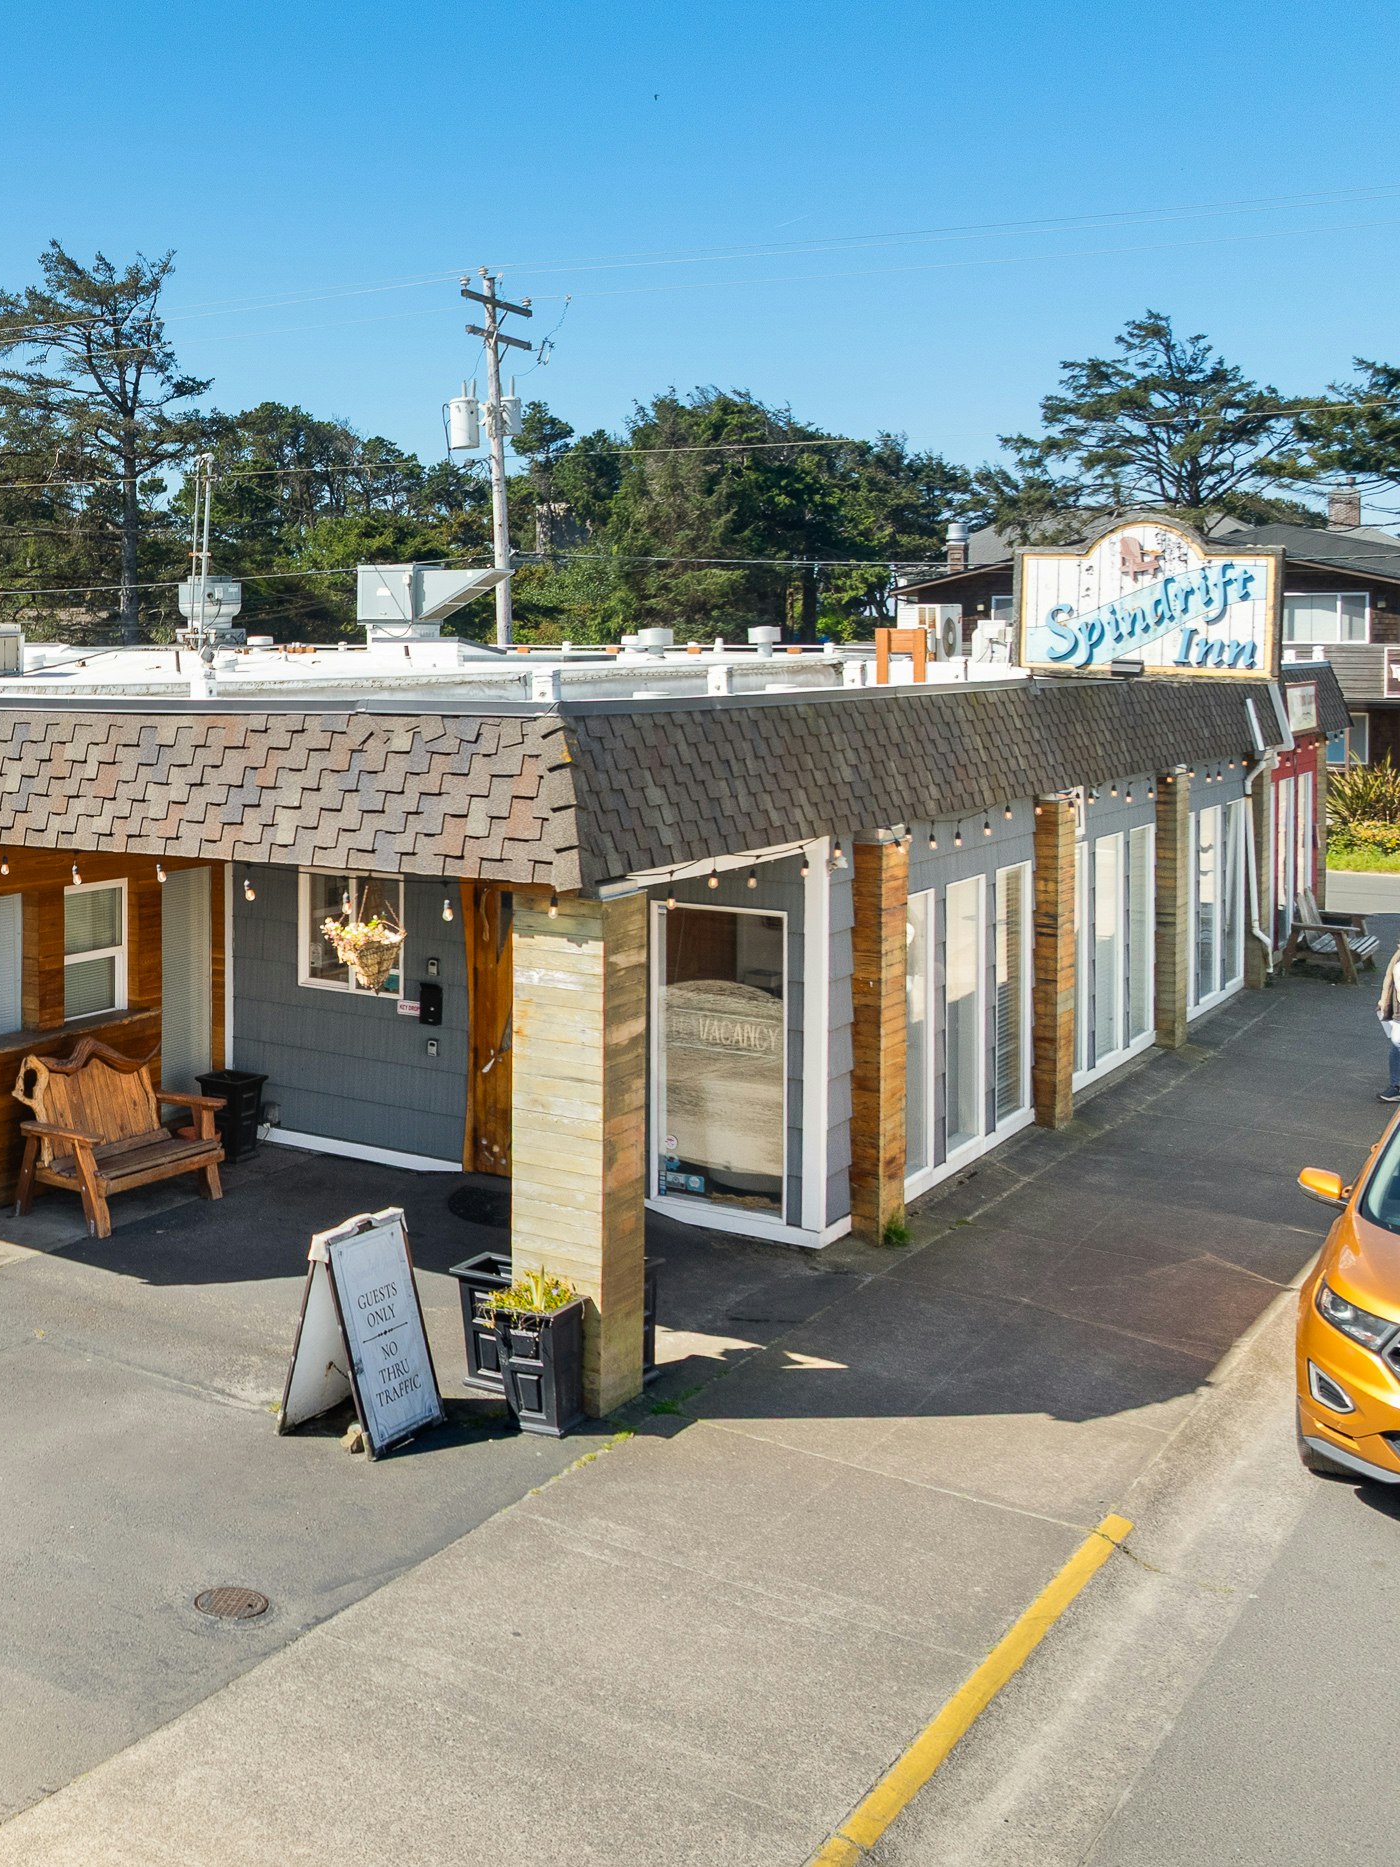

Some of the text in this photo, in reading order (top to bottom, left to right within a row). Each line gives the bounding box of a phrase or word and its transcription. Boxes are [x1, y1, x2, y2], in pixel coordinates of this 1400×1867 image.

[1045, 561, 1255, 669] Spindrift
[1173, 626, 1257, 669] Inn
[699, 1017, 779, 1051] VACANCY
[357, 1281, 398, 1310] GUESTS
[366, 1303, 396, 1328] ONLY
[380, 1340, 398, 1360] NO
[378, 1358, 411, 1384] THRU
[375, 1373, 422, 1408] TRAFFIC
